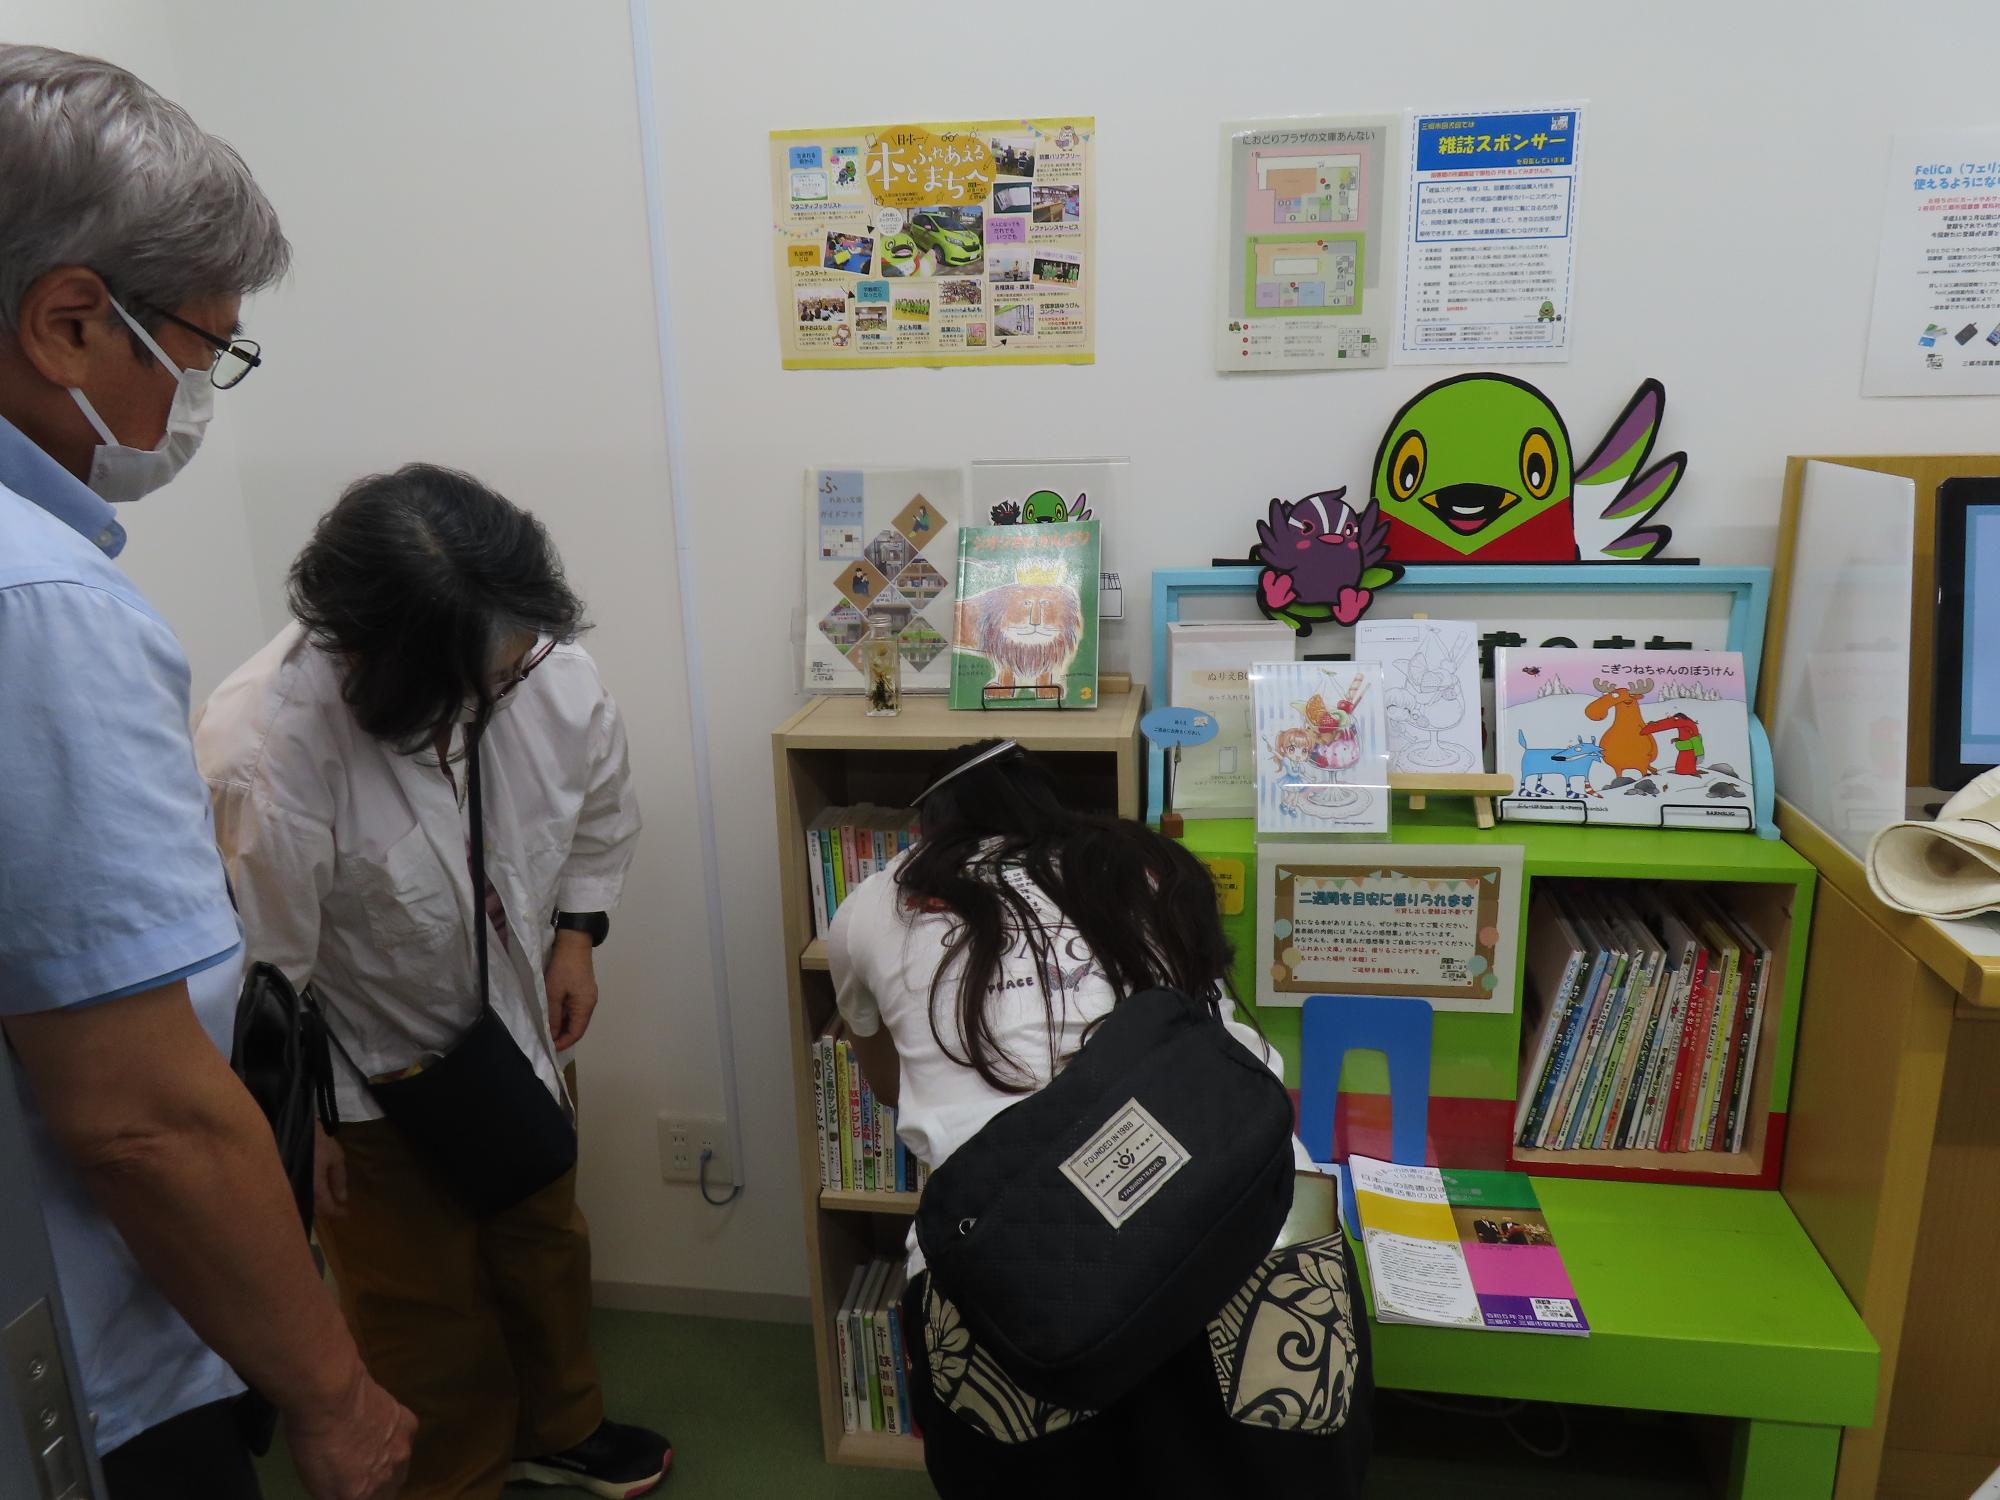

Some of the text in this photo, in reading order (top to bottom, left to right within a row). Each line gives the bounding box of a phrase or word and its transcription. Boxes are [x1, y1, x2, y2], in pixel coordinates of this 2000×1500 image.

[1438, 132, 1567, 155] 雑誌スポンサー
[924, 165, 988, 199] まちへ
[819, 476, 838, 494] ふ
[1600, 663, 1735, 677] こぎつねちゃんのぼうけん
[1299, 891, 1475, 908] 二週間を目安に借りられます
[988, 976, 1034, 994] PEACE
[1083, 1138, 1114, 1168] FOUNDED
[1117, 1121, 1135, 1137] 1988
[1143, 1160, 1163, 1180] TRAVEL
